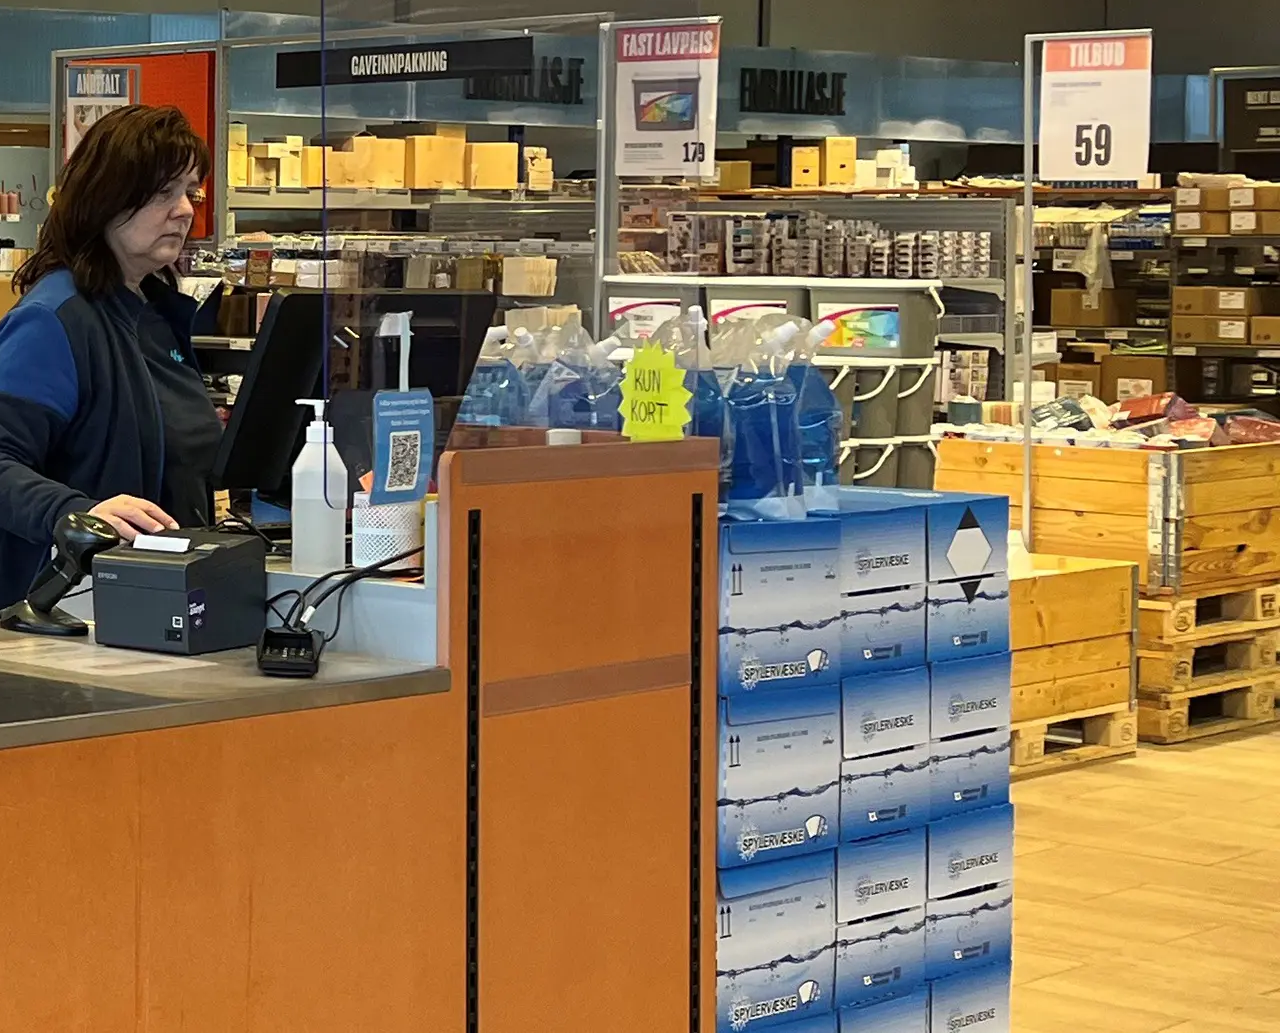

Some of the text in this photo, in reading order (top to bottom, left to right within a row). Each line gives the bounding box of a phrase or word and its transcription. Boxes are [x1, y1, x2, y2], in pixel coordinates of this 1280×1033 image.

[623, 33, 654, 57] FAST
[1069, 42, 1125, 67] TILBUD
[351, 50, 447, 76] GAVEINNPAKNING
[76, 73, 120, 94] ANBEFALT
[682, 142, 705, 162] 179
[1075, 124, 1112, 166] 59
[634, 369, 661, 394] KUN
[630, 401, 668, 424] KORT
[857, 551, 910, 571] SPYLERVÆSKE
[744, 660, 806, 680] SPYLERVÆSKE
[949, 696, 998, 714] SPYLERVÆSKE
[864, 714, 914, 733] SPYLERVÆSKE
[742, 830, 804, 851] SPYLERVÆSKE
[949, 851, 999, 871] SPYLERVÆSKE
[856, 877, 909, 898] SPYLERVÆSKE
[733, 996, 798, 1021] SPYLERVÆSKE
